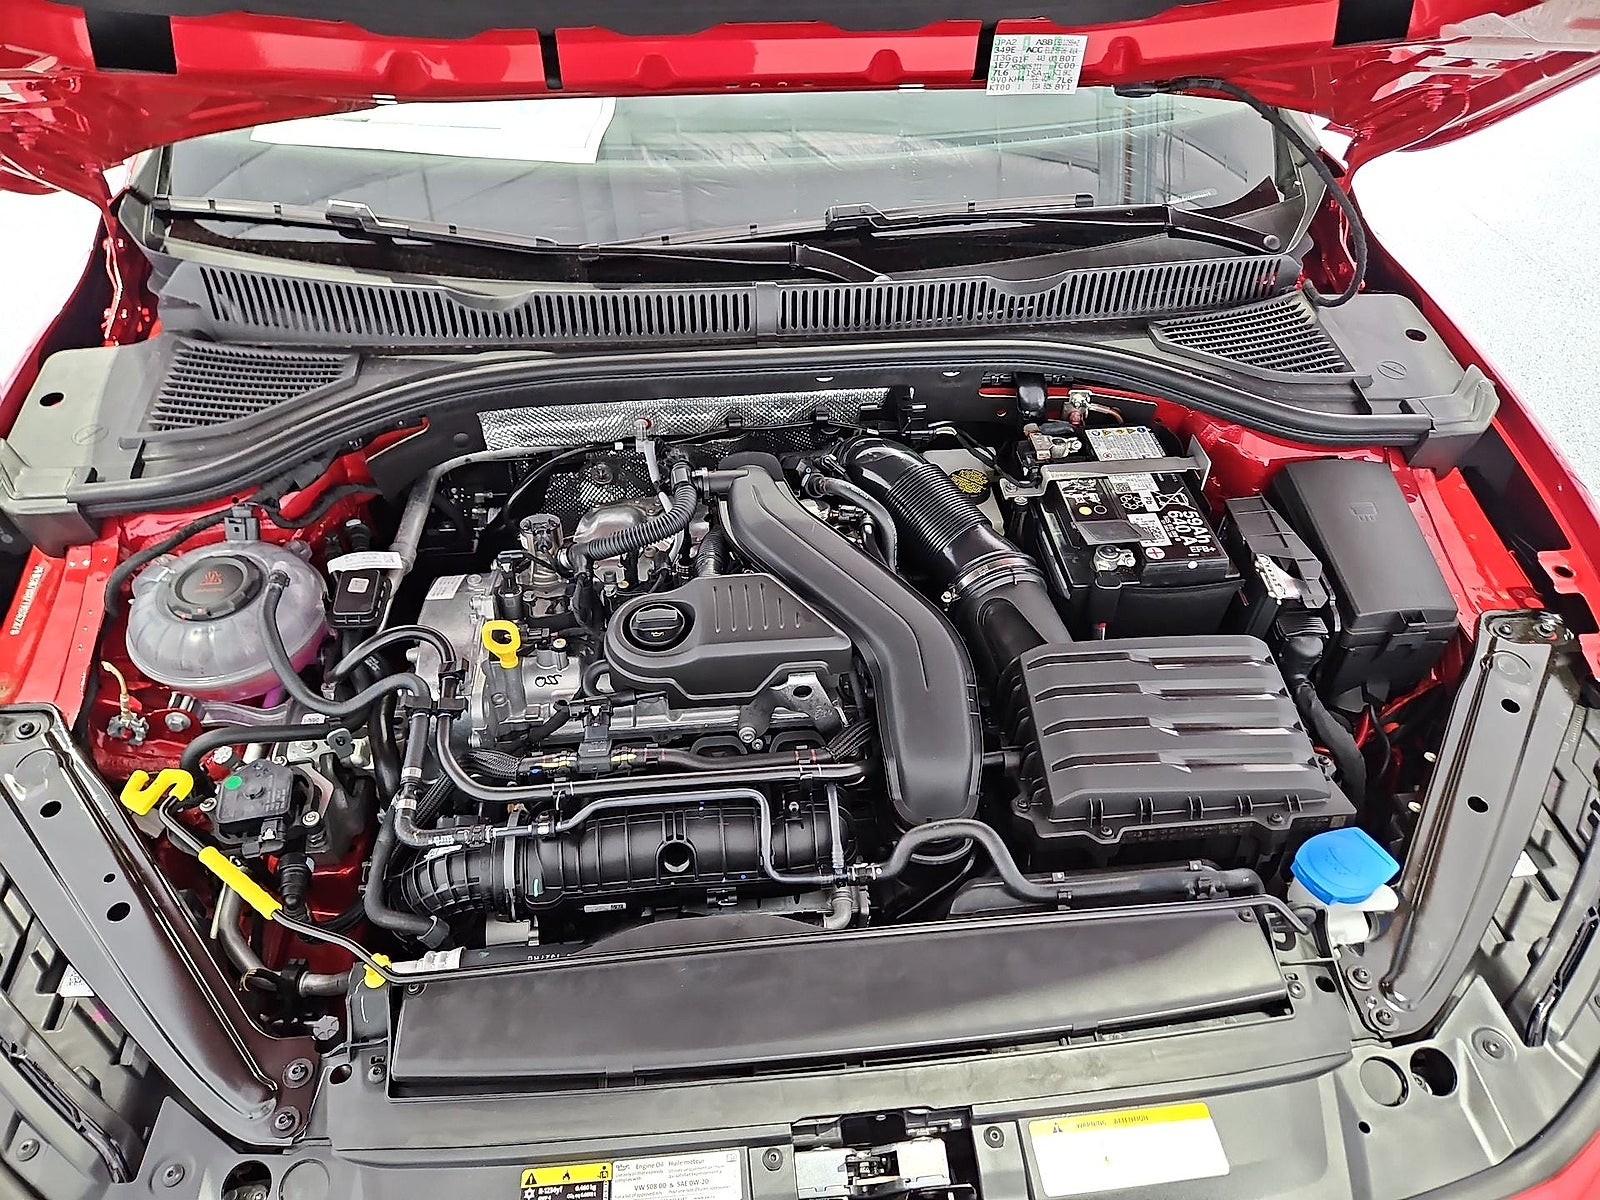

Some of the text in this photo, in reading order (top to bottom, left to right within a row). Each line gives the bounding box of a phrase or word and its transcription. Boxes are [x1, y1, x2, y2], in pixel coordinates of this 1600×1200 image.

[1167, 510, 1192, 533] 640
[1182, 510, 1212, 544] 59Ah
[635, 1163, 655, 1171] Engine
